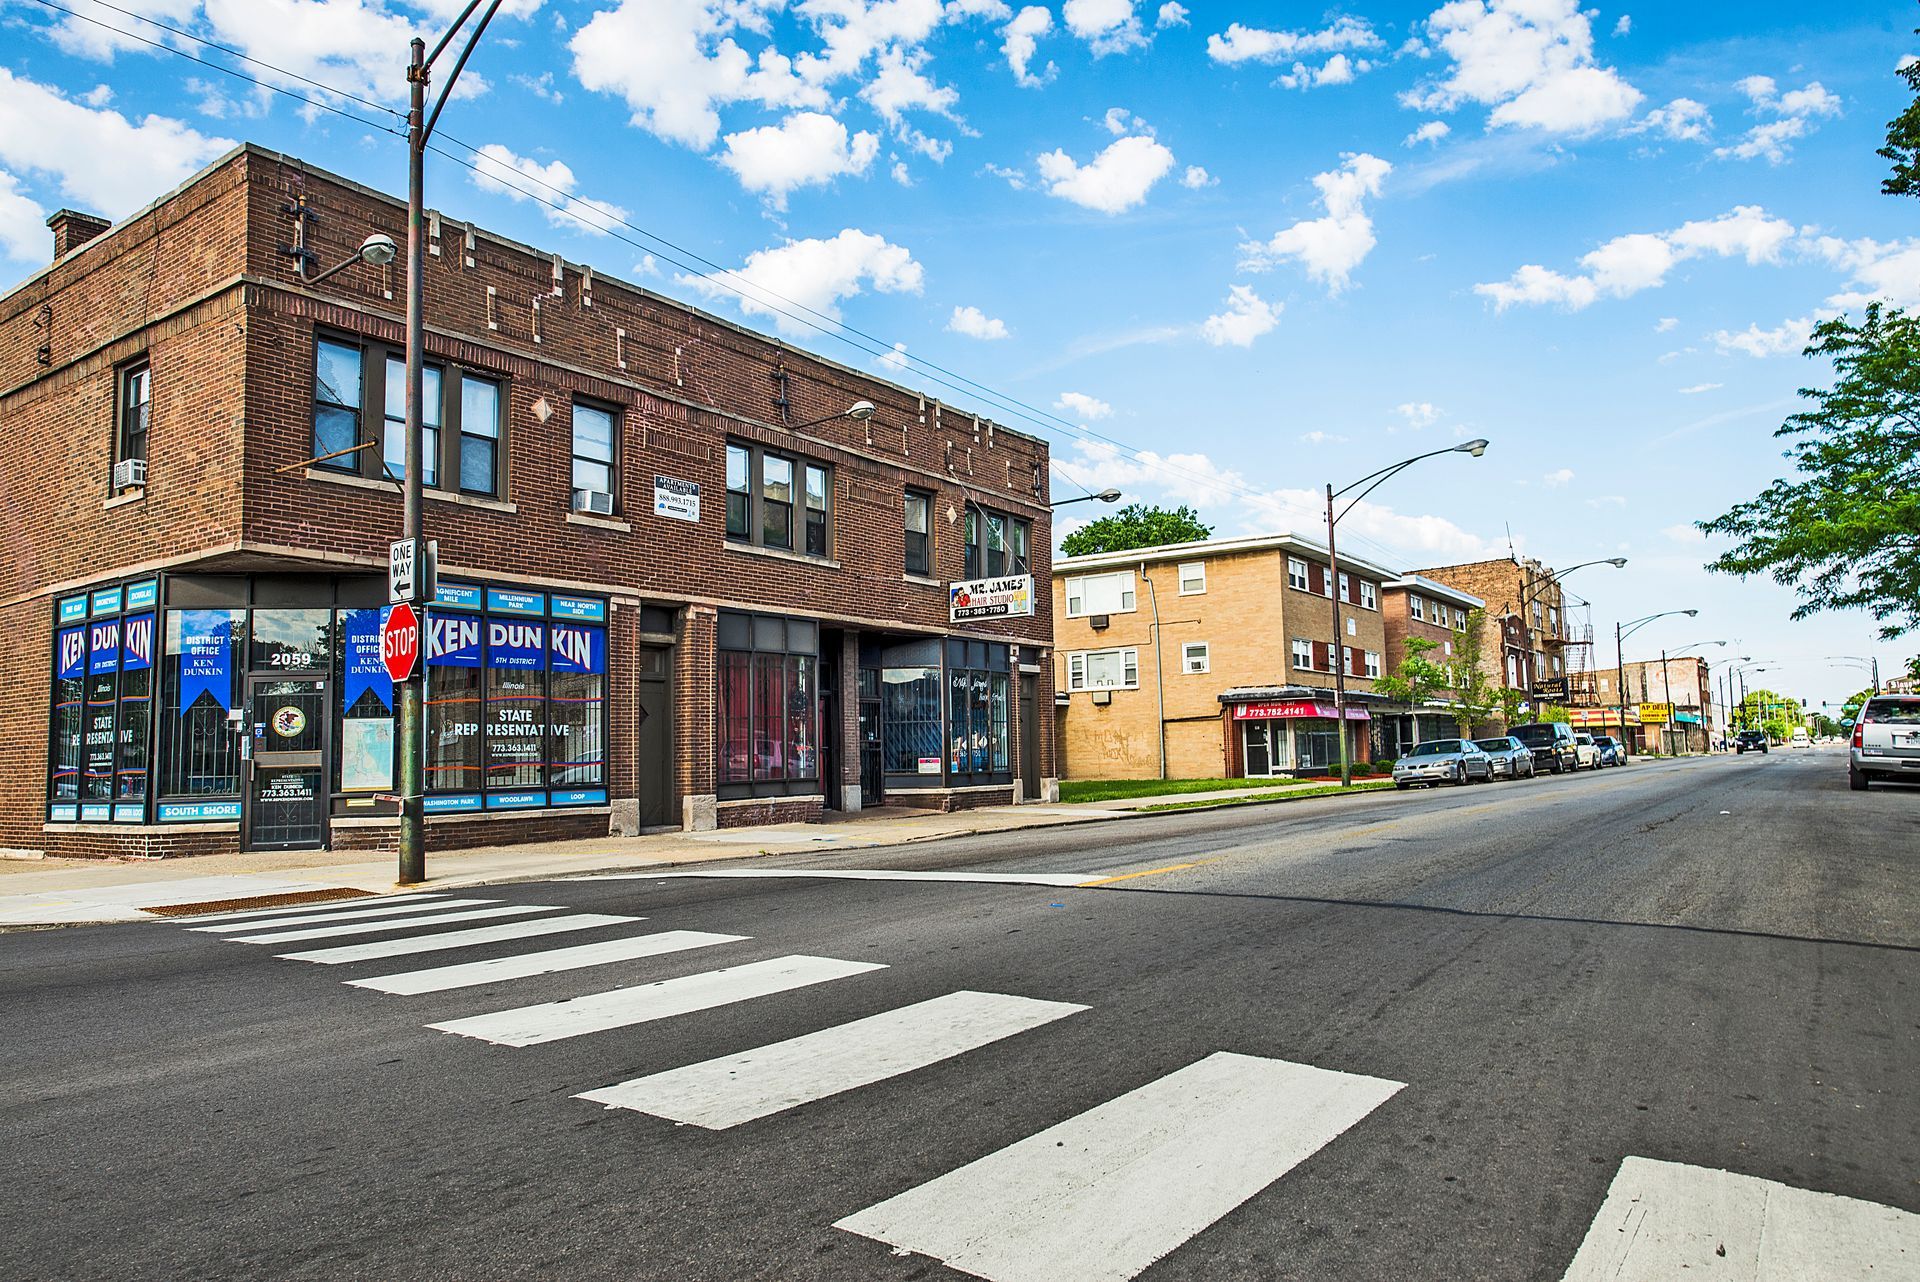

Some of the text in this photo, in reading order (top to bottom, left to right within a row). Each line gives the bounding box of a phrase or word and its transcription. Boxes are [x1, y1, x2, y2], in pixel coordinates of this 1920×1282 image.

[660, 477, 696, 490] APARTMENTS
[663, 484, 693, 495] AVAILABLE
[658, 494, 696, 507] 888.993.1715
[393, 545, 412, 561] ONE
[392, 561, 412, 578] WAY
[436, 588, 472, 597] AGNIFICENT
[499, 594, 533, 604] MILLENNIUM
[971, 594, 1014, 606] HAIR STUDIO
[577, 602, 596, 610] NORTH
[186, 635, 224, 645] DISTRICT
[351, 635, 380, 644] DISTRI
[386, 625, 416, 659] STOP
[427, 618, 479, 660] KEN
[191, 646, 219, 655] OFFICE
[356, 645, 380, 654] OFFIC
[193, 659, 214, 667] KEN
[271, 653, 311, 665] 2059
[360, 656, 380, 665] KEN
[184, 668, 223, 676] DUNKIN
[502, 681, 525, 689] Illinois
[499, 710, 532, 721] STATE
[93, 716, 112, 729] STATE
[492, 744, 537, 753] 773.363.1411
[261, 788, 312, 797] 773.363.1411
[165, 805, 236, 816] SOUTH SHORE
